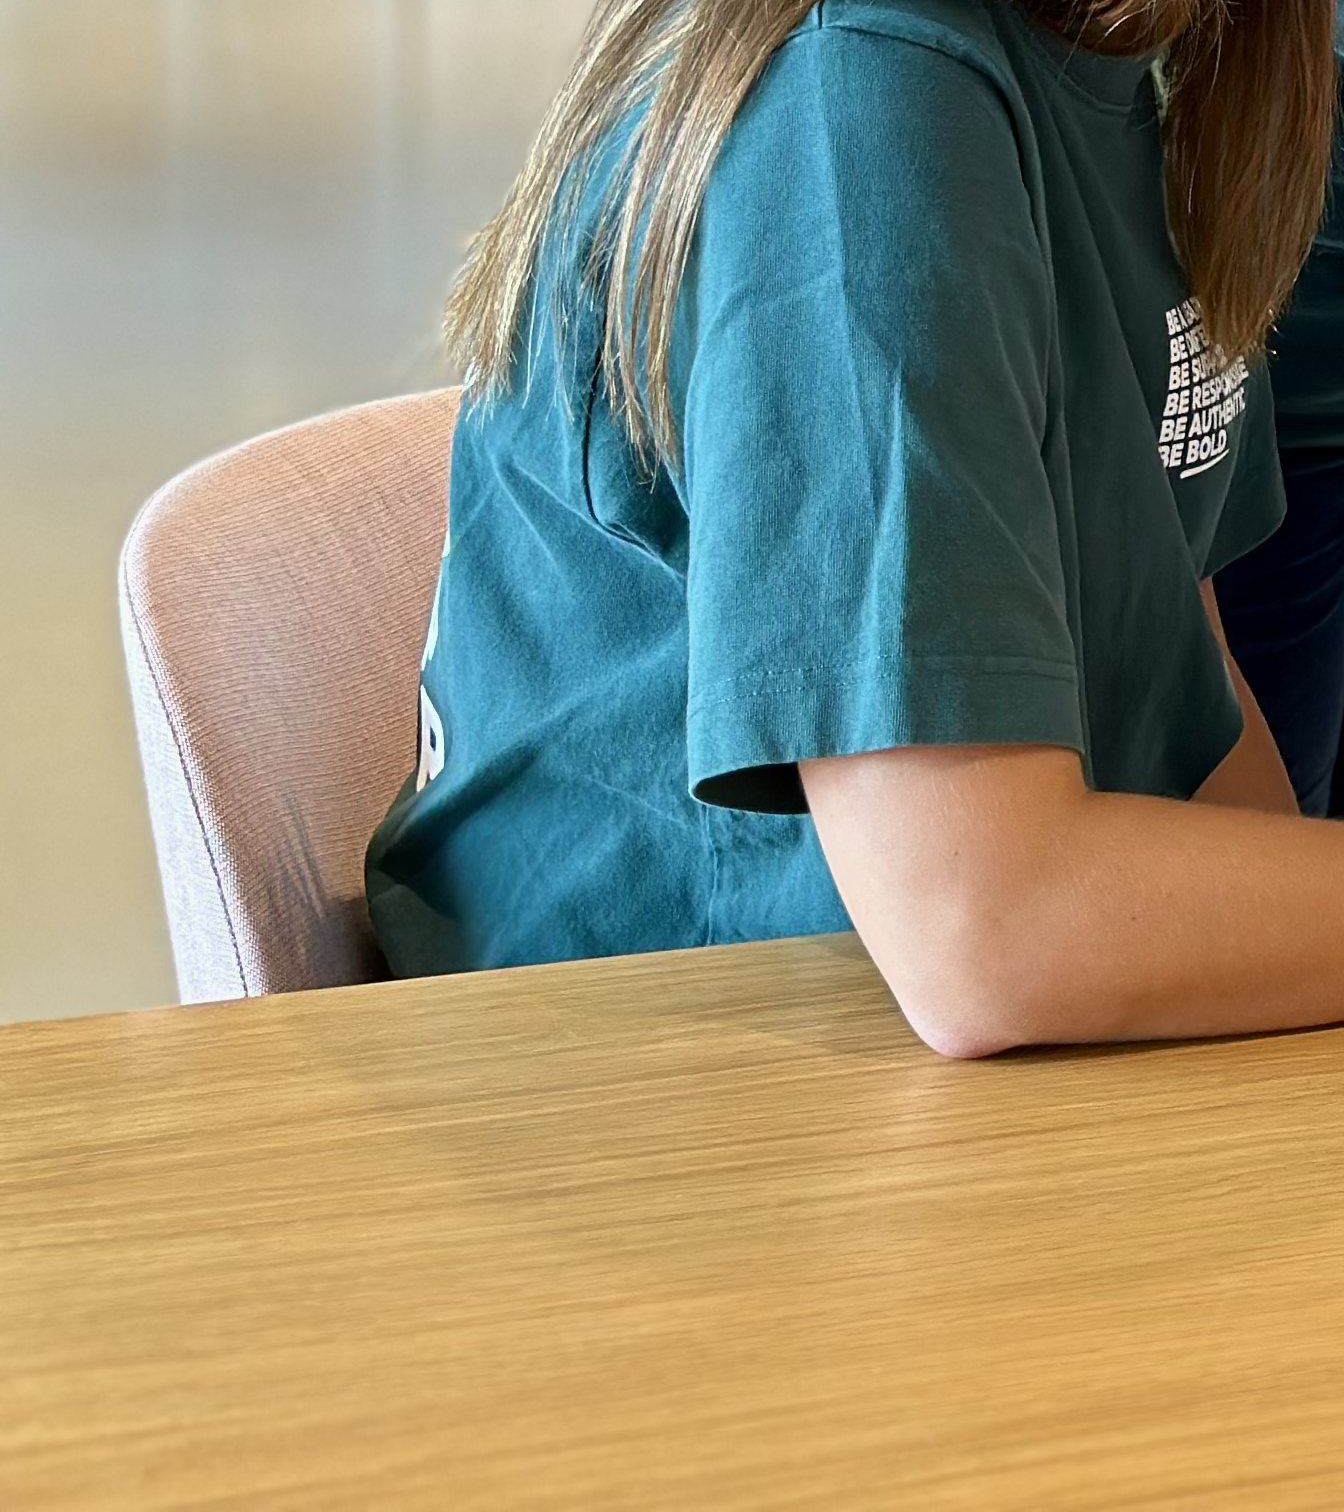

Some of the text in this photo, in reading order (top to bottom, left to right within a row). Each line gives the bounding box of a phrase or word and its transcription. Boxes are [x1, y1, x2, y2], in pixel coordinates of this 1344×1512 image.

[1170, 335, 1188, 364] BE
[1168, 362, 1190, 390] BE
[1163, 389, 1190, 417] BE
[1159, 416, 1188, 444] BE
[1186, 429, 1227, 464] BOLD
